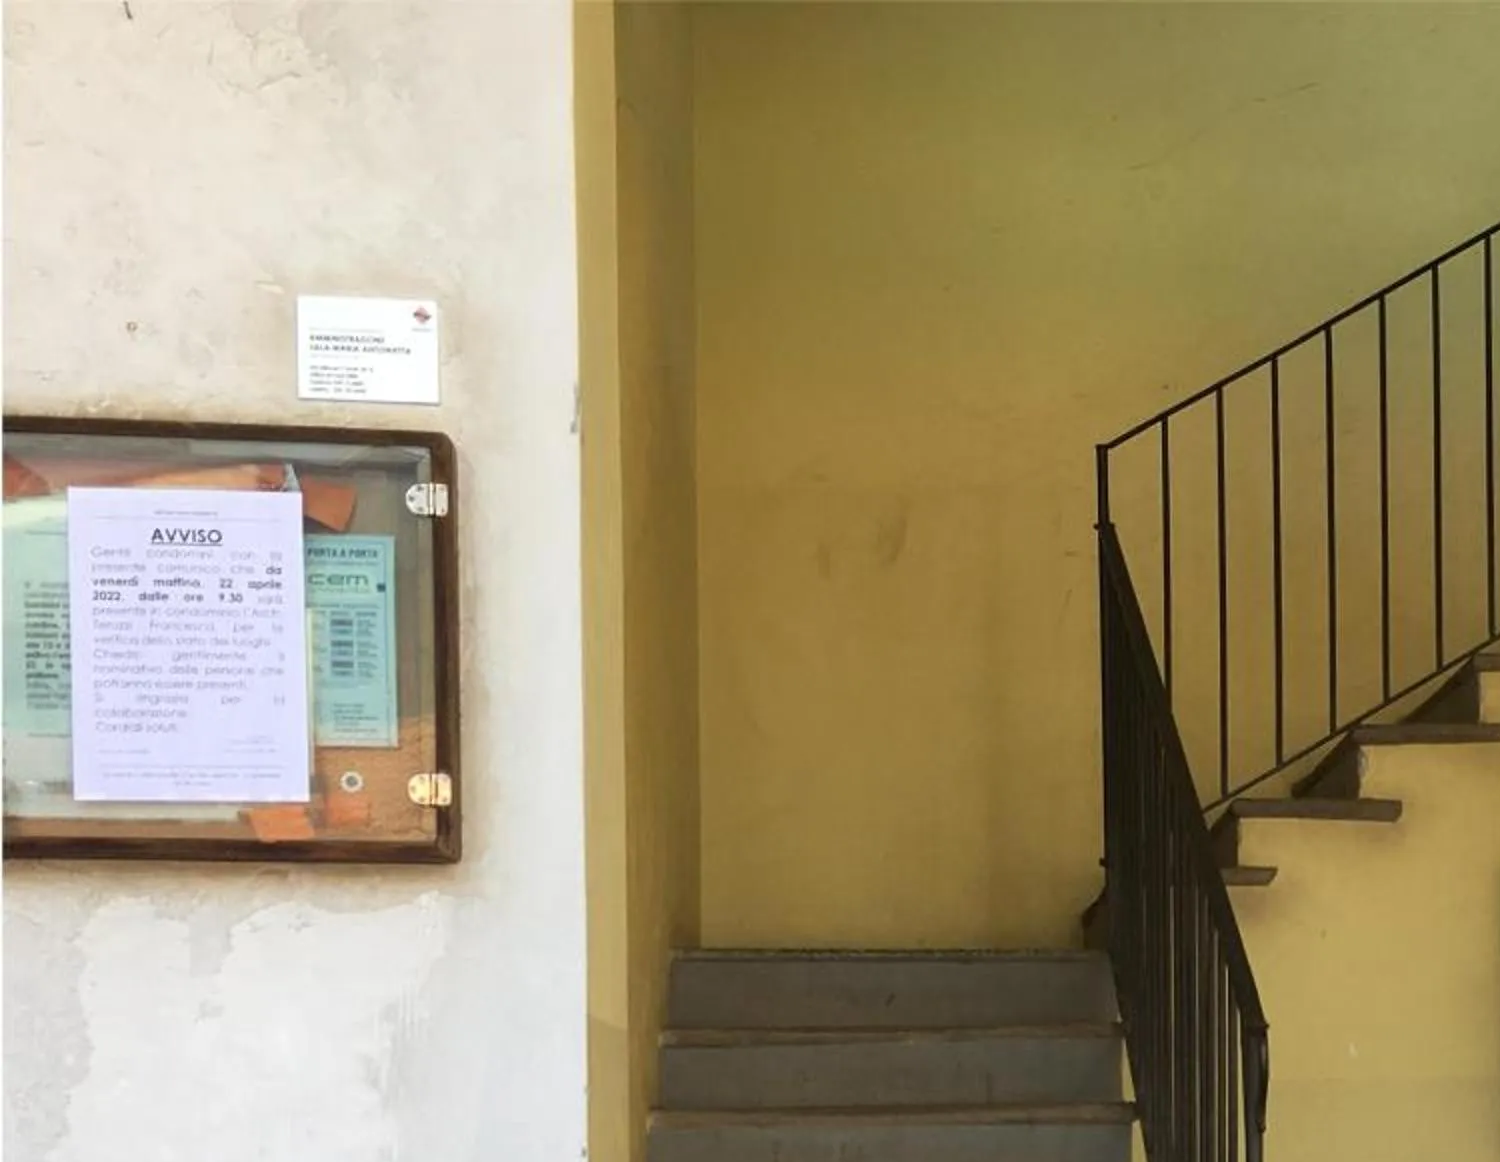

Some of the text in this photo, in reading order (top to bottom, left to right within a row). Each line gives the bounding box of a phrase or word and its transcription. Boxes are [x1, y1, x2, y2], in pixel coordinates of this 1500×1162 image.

[151, 528, 223, 546] AVVISO
[266, 564, 282, 575] da
[219, 578, 233, 588] 22
[247, 578, 282, 592] aprile
[138, 591, 169, 601] dalle
[183, 593, 204, 602] ore
